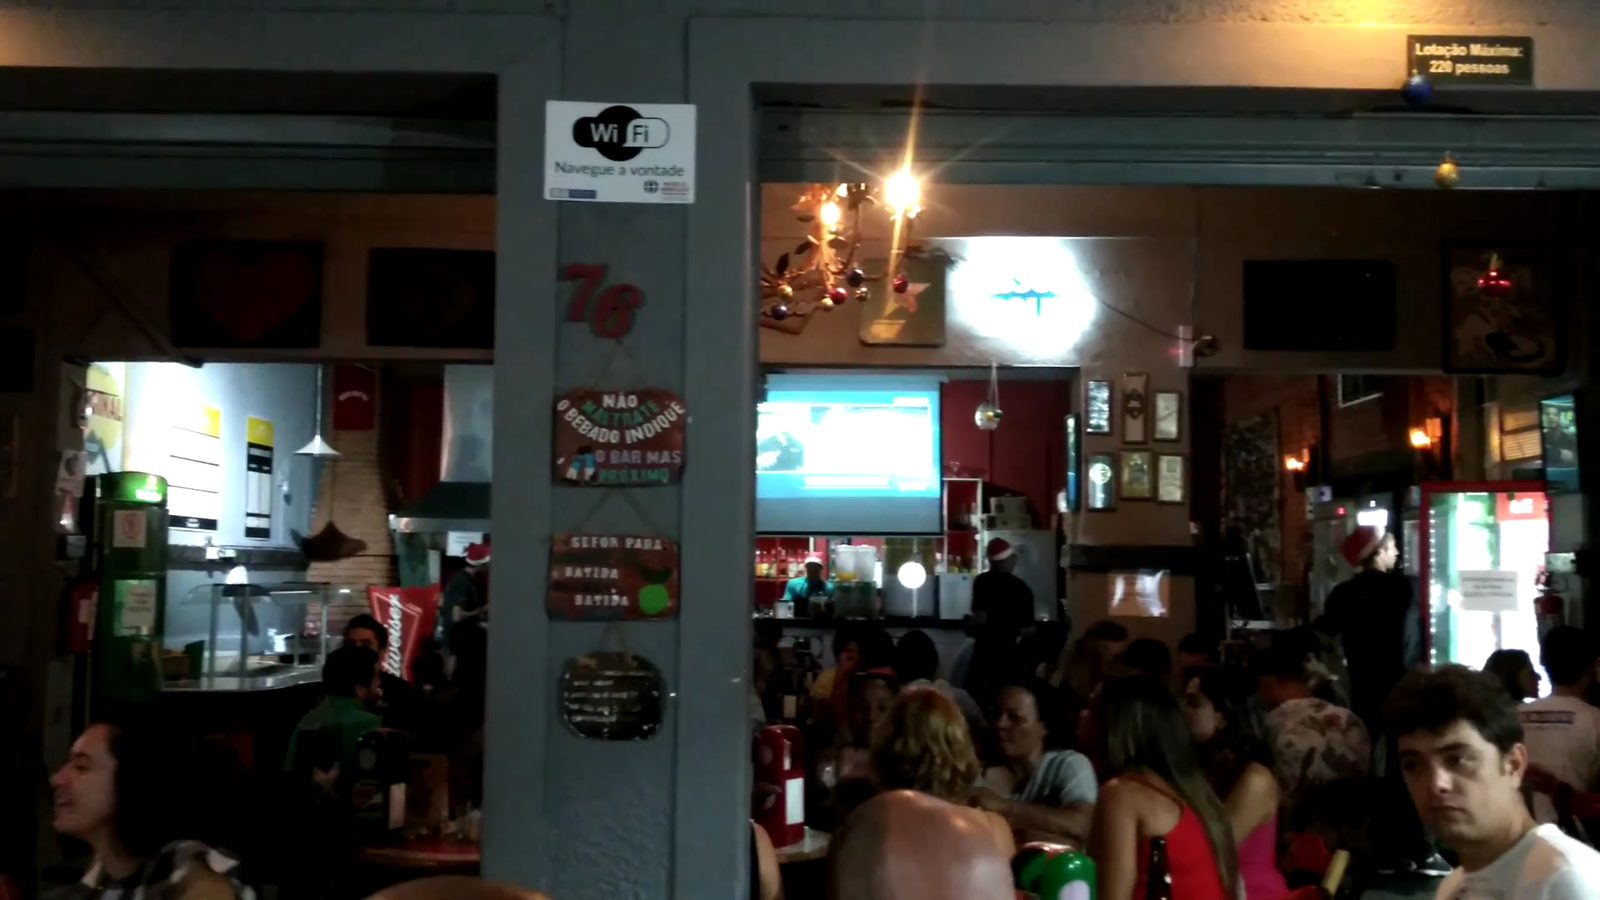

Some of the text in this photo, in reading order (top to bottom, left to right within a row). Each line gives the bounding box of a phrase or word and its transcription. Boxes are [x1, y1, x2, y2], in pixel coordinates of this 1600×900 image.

[1415, 43, 1523, 58] Lotação Máxima:
[1429, 60, 1510, 76] 220 pessoas
[590, 122, 649, 143] Wi Fi
[554, 161, 615, 177] Navegue
[630, 164, 686, 177] vontade
[557, 262, 647, 340] 76
[602, 392, 638, 409] NÃO
[625, 400, 686, 444] INDIQUE
[609, 449, 641, 464] BAR
[624, 537, 663, 550] PARA
[564, 566, 619, 579] BATIDA
